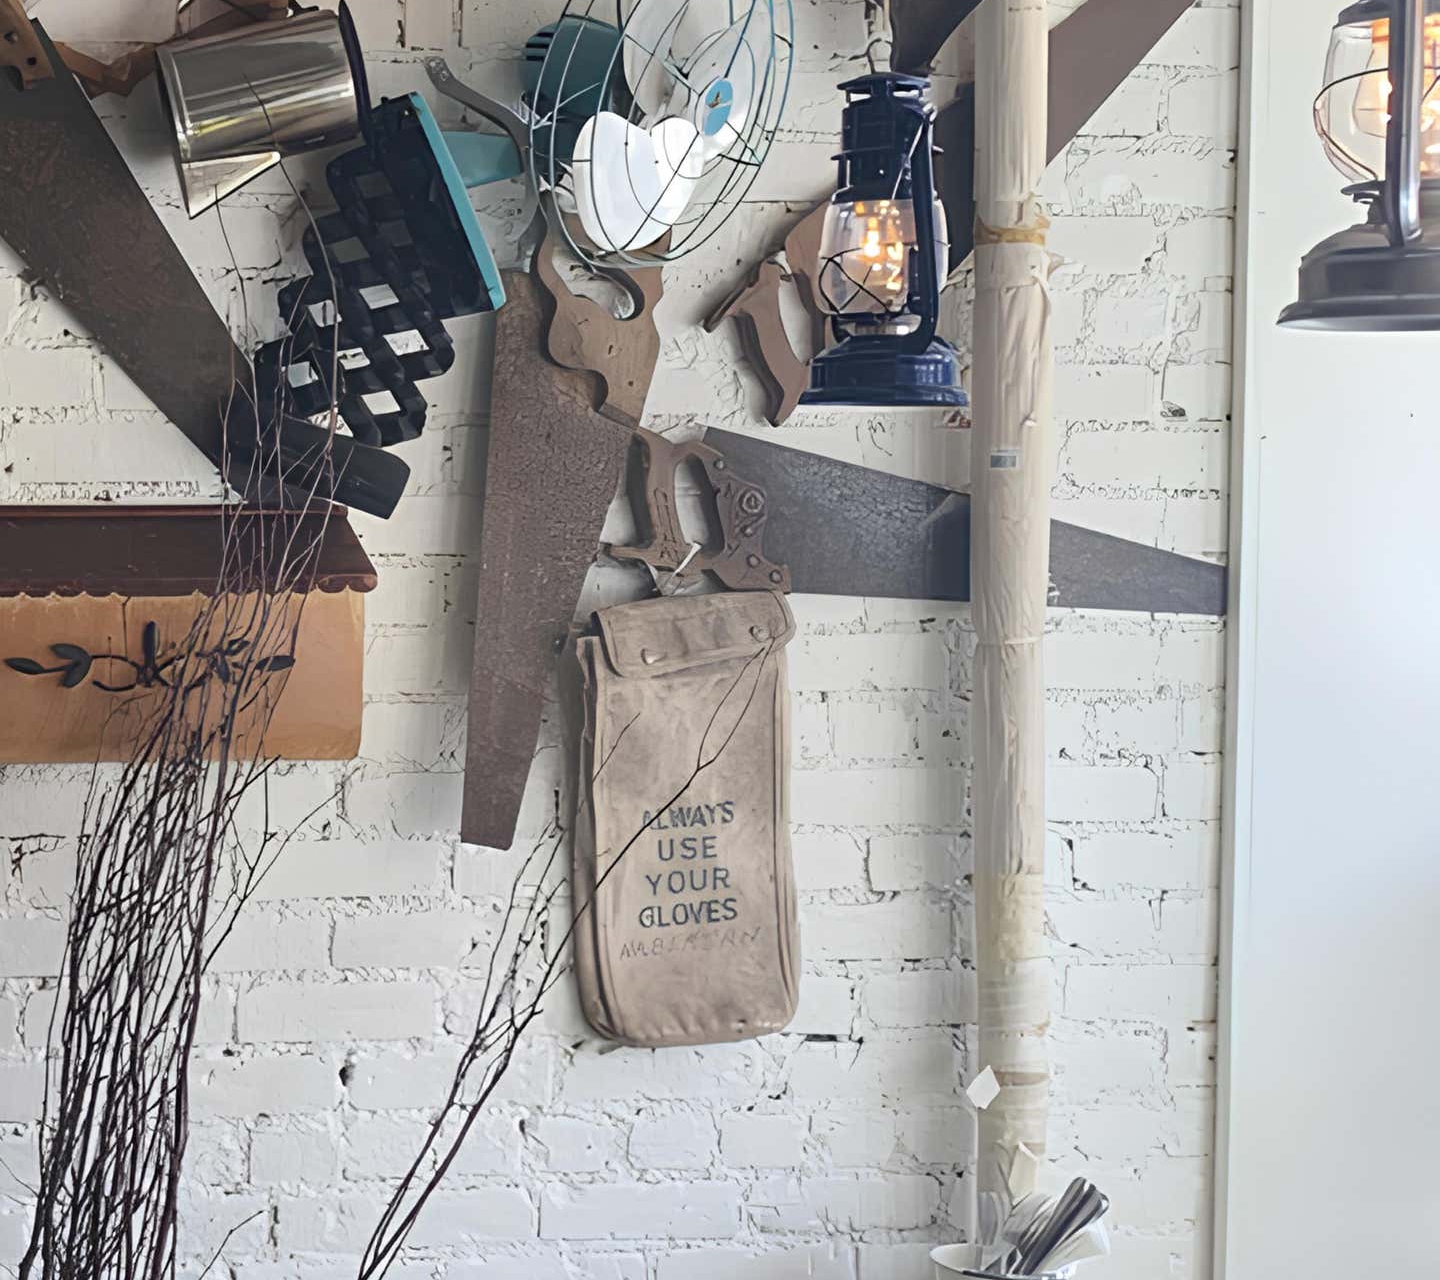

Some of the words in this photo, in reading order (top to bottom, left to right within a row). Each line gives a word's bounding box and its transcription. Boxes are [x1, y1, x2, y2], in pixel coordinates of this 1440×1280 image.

[658, 836, 718, 861] USE
[645, 867, 731, 896] YOUR
[639, 898, 738, 928] GLOVES
